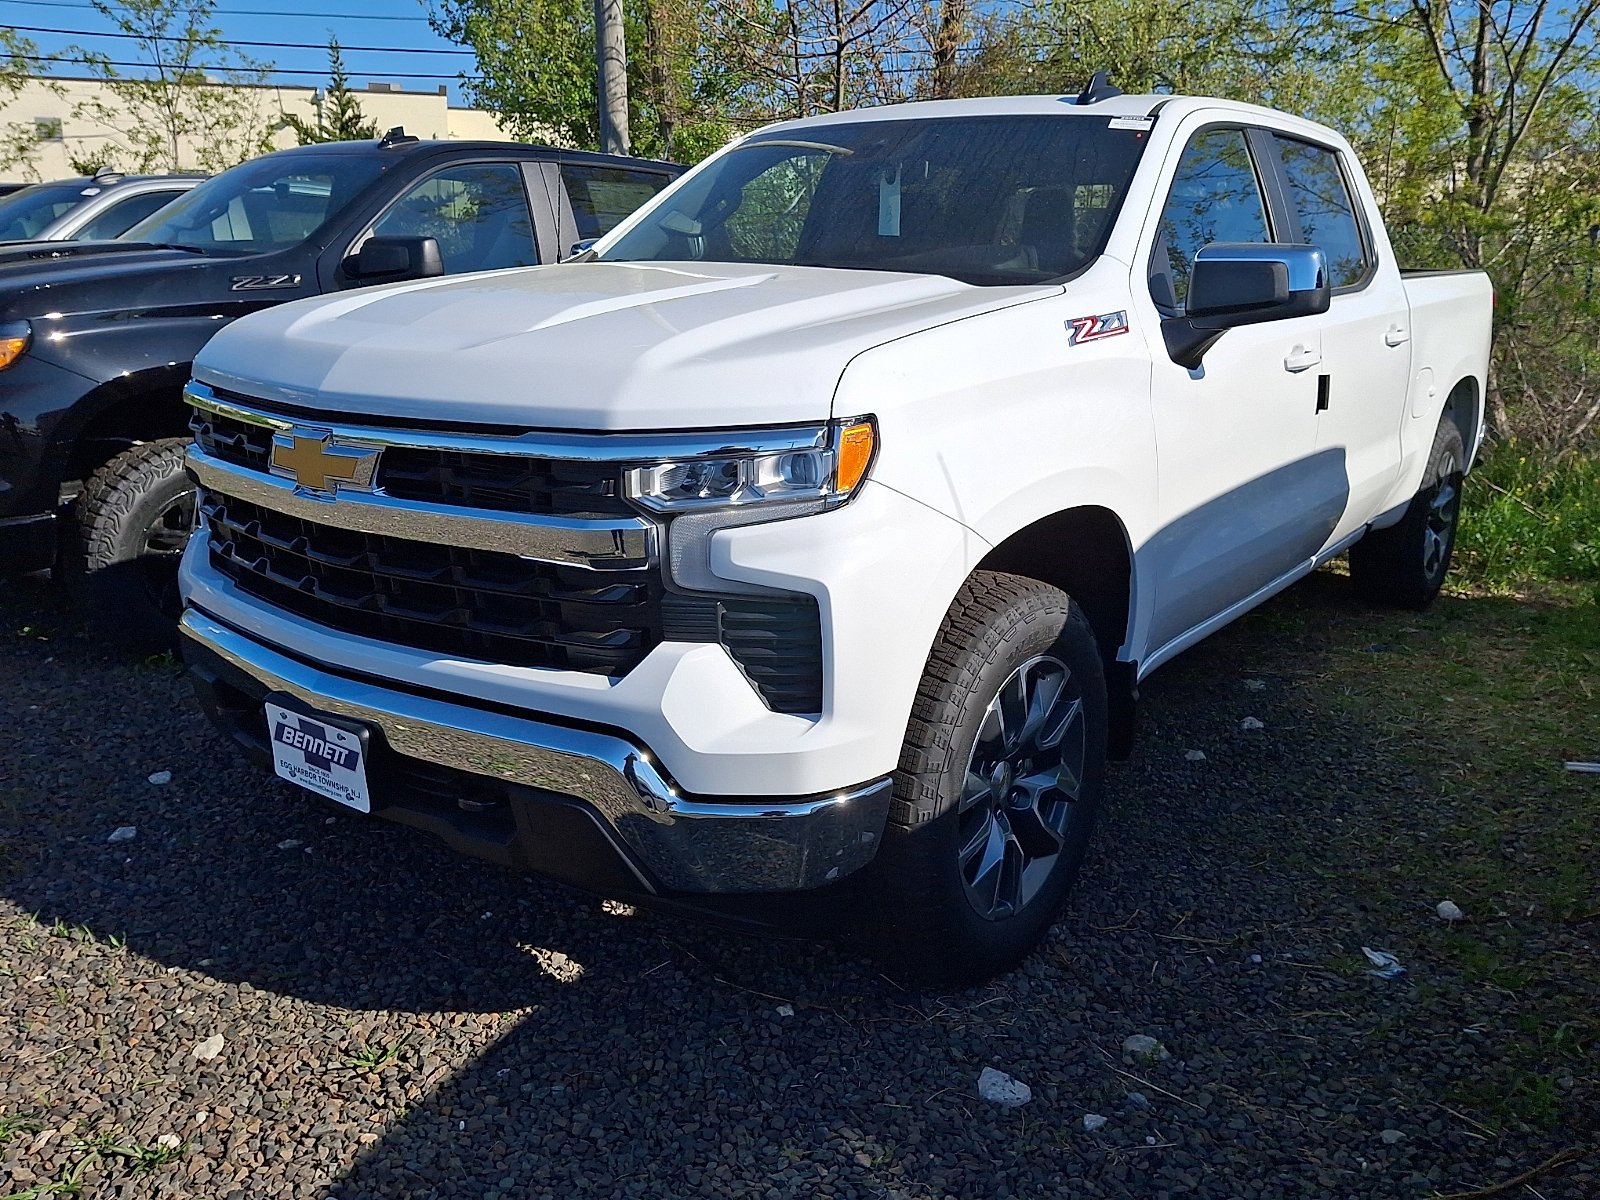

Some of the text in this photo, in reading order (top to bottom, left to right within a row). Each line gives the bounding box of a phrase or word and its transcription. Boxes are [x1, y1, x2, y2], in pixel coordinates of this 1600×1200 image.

[1064, 310, 1129, 347] Z71
[282, 726, 349, 765] BENNETT
[280, 759, 293, 771] EGG
[293, 765, 317, 781] HARBOR
